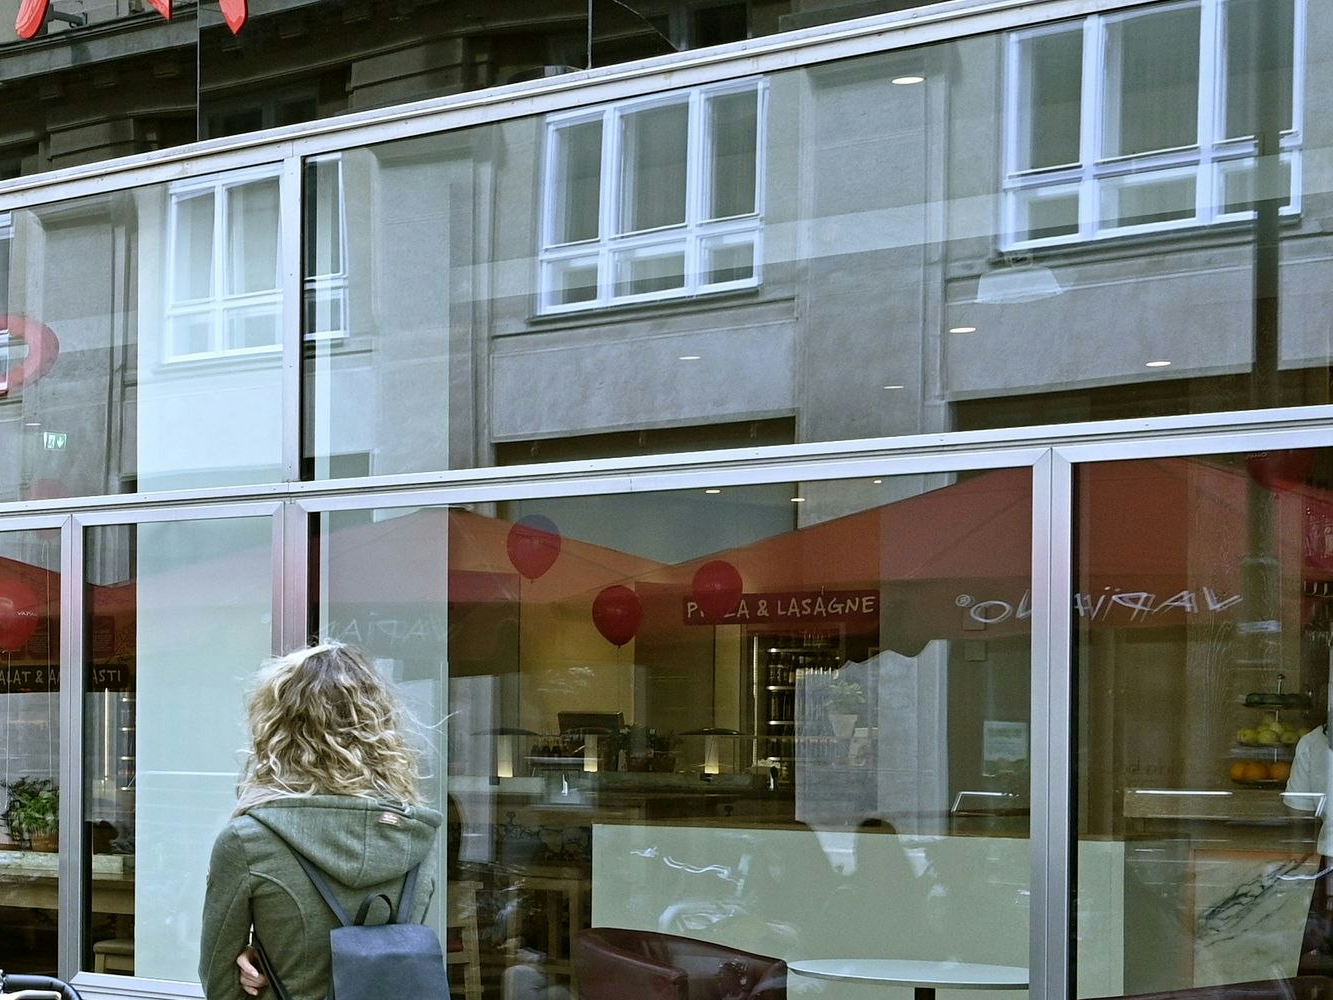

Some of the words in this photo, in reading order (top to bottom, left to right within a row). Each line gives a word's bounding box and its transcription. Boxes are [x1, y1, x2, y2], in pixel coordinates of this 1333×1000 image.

[757, 600, 769, 617] &
[777, 596, 876, 617] LASAGNE
[35, 670, 44, 684] &
